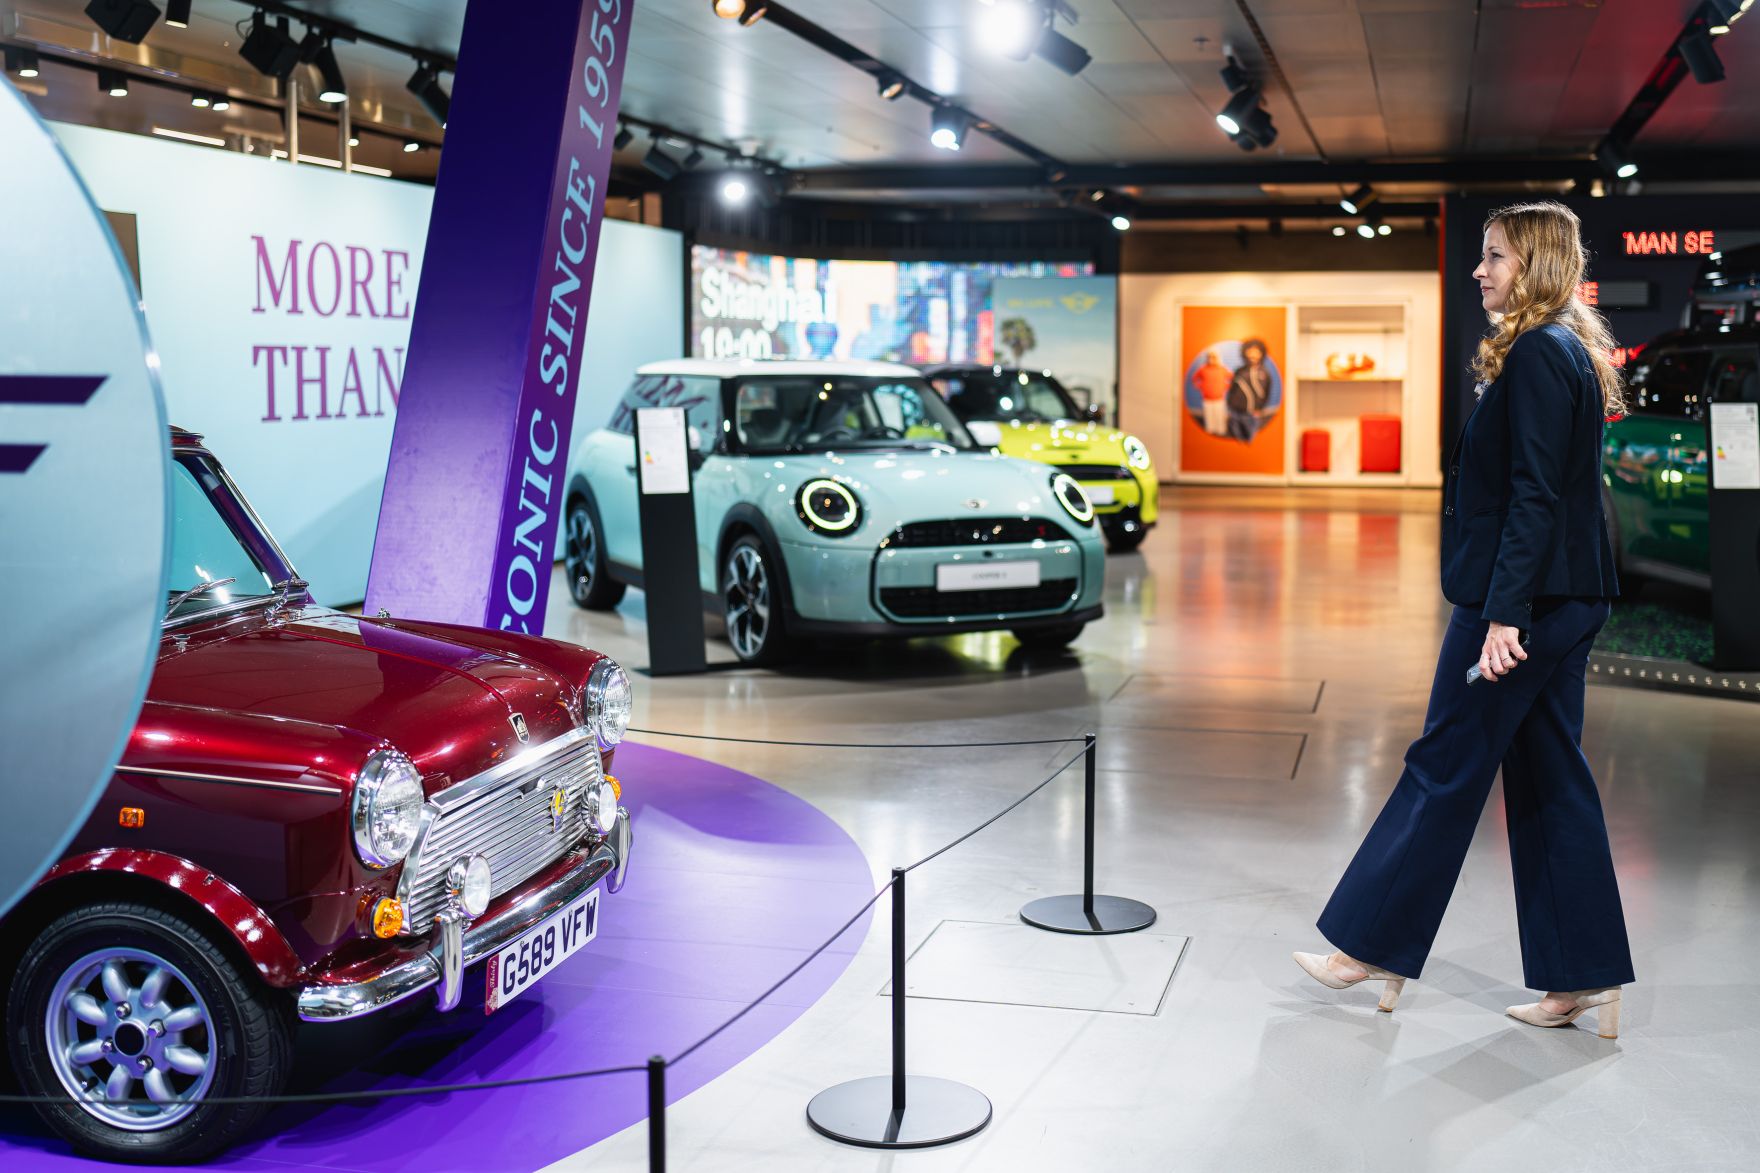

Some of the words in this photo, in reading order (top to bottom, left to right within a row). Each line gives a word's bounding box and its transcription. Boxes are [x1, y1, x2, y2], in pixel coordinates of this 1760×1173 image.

[251, 235, 410, 320] MORE
[540, 157, 596, 397] SINCE
[1623, 231, 1677, 255] MAN
[1684, 230, 1715, 254] SE
[701, 266, 837, 332] Shanghai
[252, 345, 405, 423] THAN
[502, 925, 556, 996] G589
[561, 896, 597, 954] VFW
